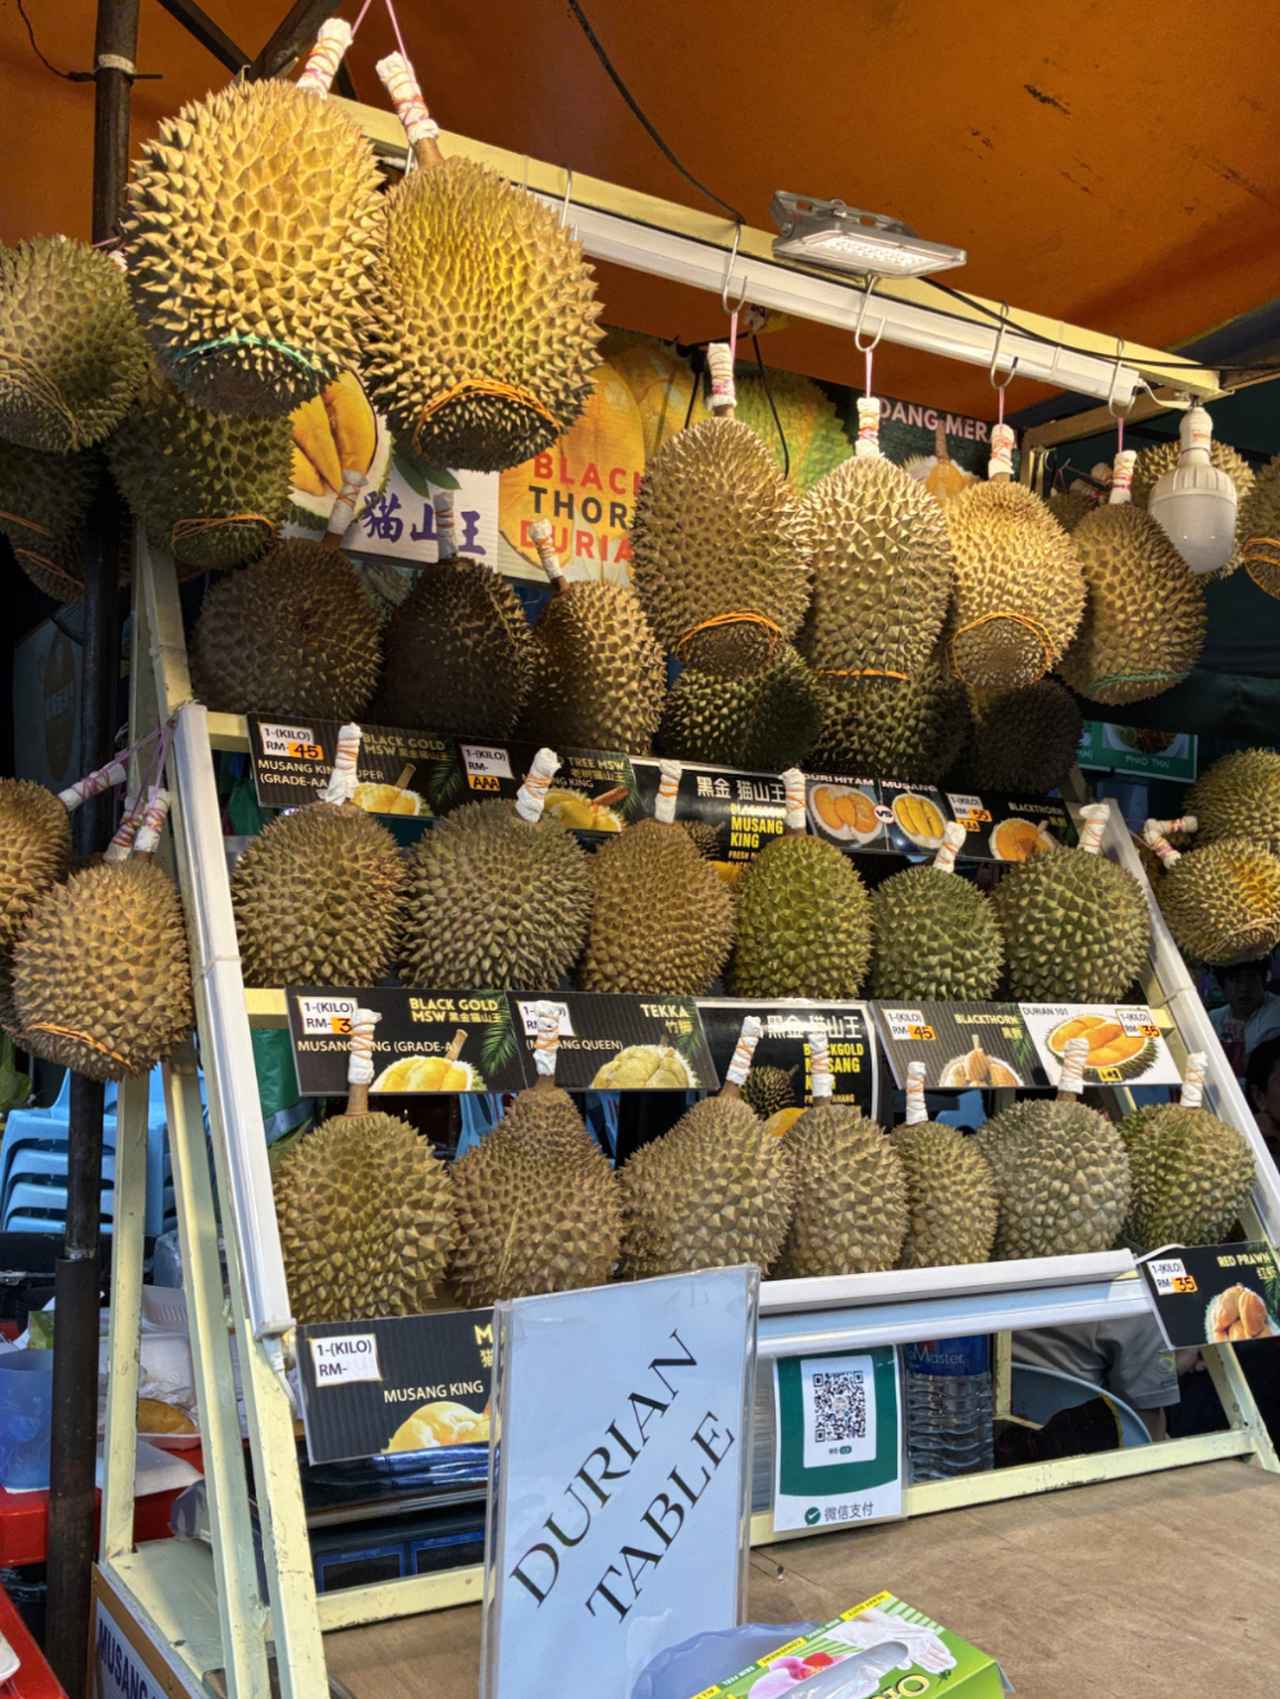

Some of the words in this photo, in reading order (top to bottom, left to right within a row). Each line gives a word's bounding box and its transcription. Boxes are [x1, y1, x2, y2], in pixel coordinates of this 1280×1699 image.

[946, 414, 992, 443] MER
[528, 485, 634, 530] THOR
[520, 520, 634, 565] DURIA
[294, 745, 319, 759] 45
[408, 738, 446, 751] GOLD
[258, 759, 312, 774] MUSANG
[315, 764, 336, 776] KIN
[259, 773, 329, 789] (GRADE-AA
[833, 775, 875, 786] HITAM
[881, 780, 938, 793] MUSANG
[730, 816, 784, 835] MUSANG
[730, 832, 760, 849] KING
[304, 1002, 355, 1014] 1-(KILO)
[409, 997, 454, 1012] BLACK
[458, 999, 499, 1012] GOLD
[640, 1003, 690, 1019] TEKKA
[1023, 1006, 1056, 1017] DURIAN
[412, 1010, 446, 1023] MSW
[954, 1013, 1020, 1026] BLACKTHORN
[339, 1017, 352, 1033] 3
[914, 1026, 933, 1039] 45
[1142, 1025, 1160, 1037] 35
[583, 1039, 624, 1052] QUEEN)
[803, 1043, 864, 1057] BKGOLD
[805, 1057, 860, 1073] SANG
[1217, 1254, 1236, 1268] RED
[1177, 1276, 1196, 1291] 35
[316, 1339, 372, 1358] 1-(KILO)
[319, 1362, 348, 1377] RM-
[384, 1383, 447, 1404] MUSANG
[449, 1379, 484, 1397] KING
[509, 1327, 698, 1608] DURIAN
[584, 1410, 736, 1624] TABLE
[824, 1501, 874, 1522] 微信支付
